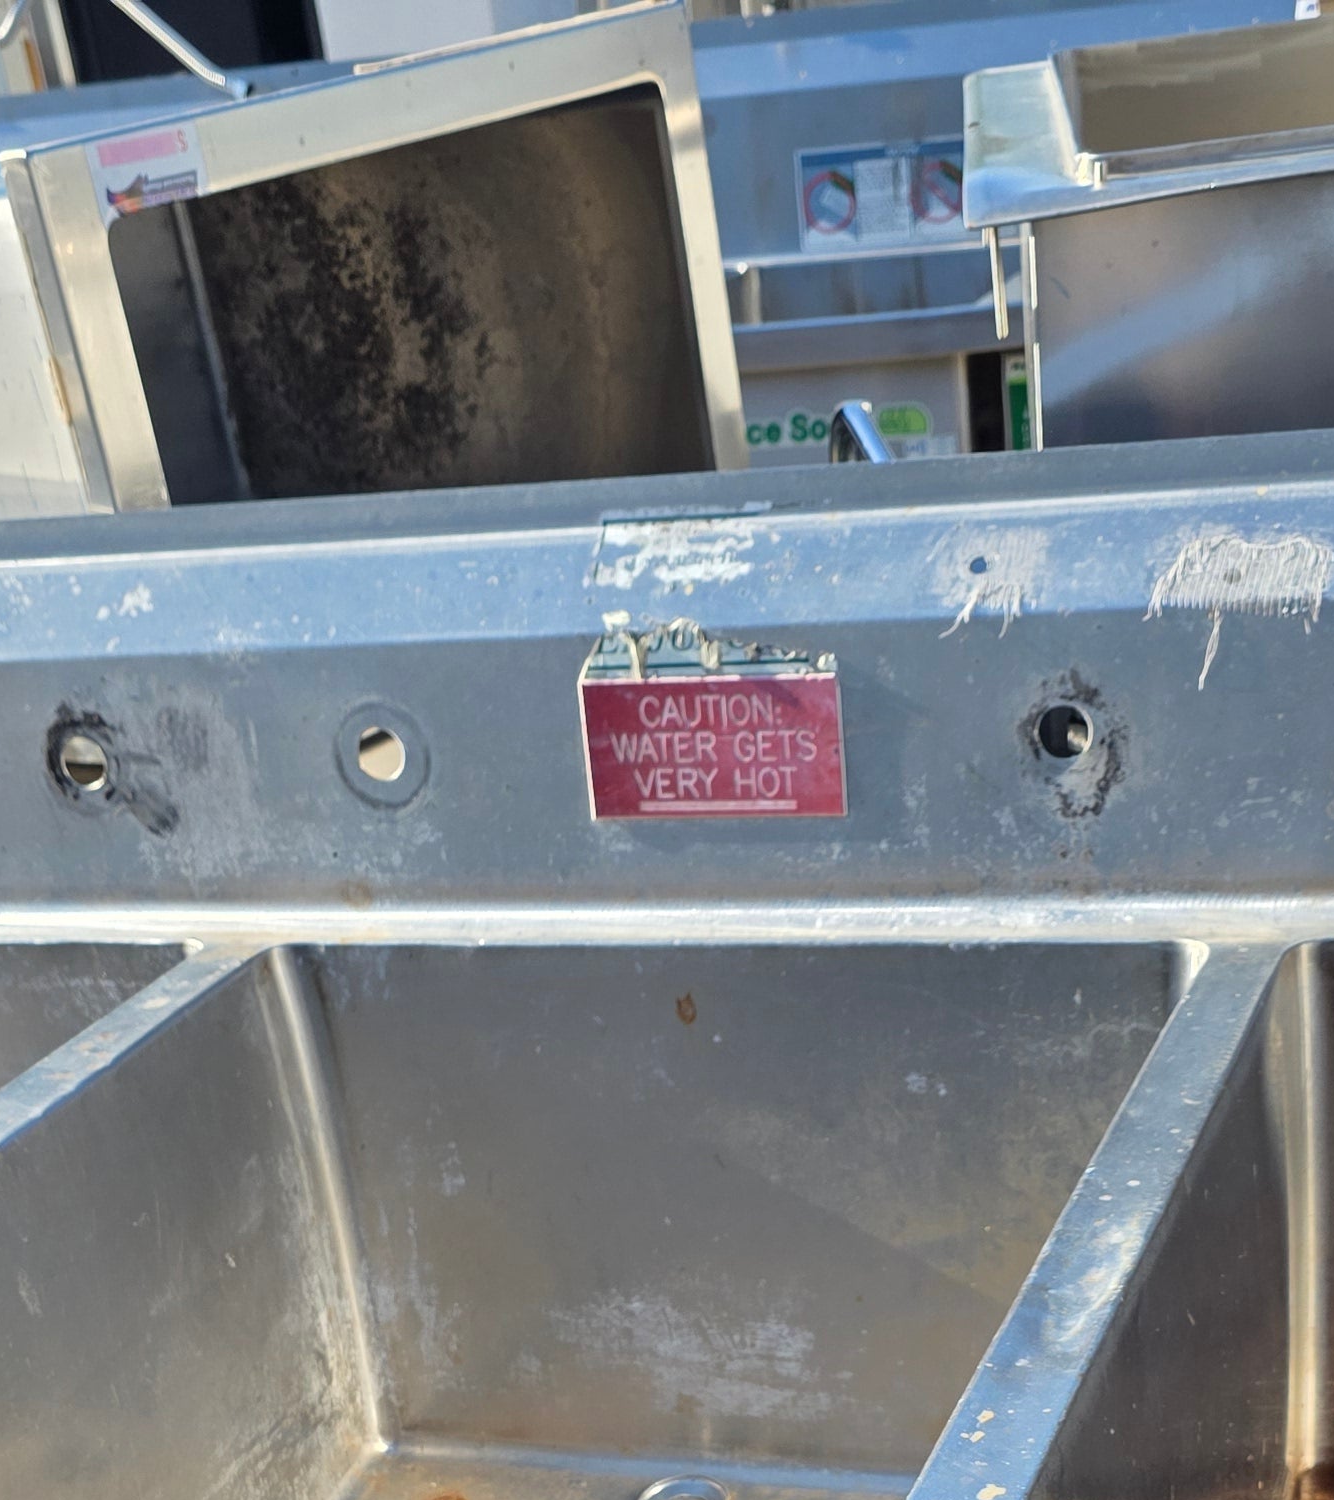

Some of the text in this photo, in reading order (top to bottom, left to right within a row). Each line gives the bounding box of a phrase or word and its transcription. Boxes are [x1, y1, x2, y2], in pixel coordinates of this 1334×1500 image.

[746, 412, 829, 445] ce So
[638, 694, 783, 729] CAUTION:
[610, 729, 818, 764] WATER GETS
[633, 765, 798, 799] VERY HOT
